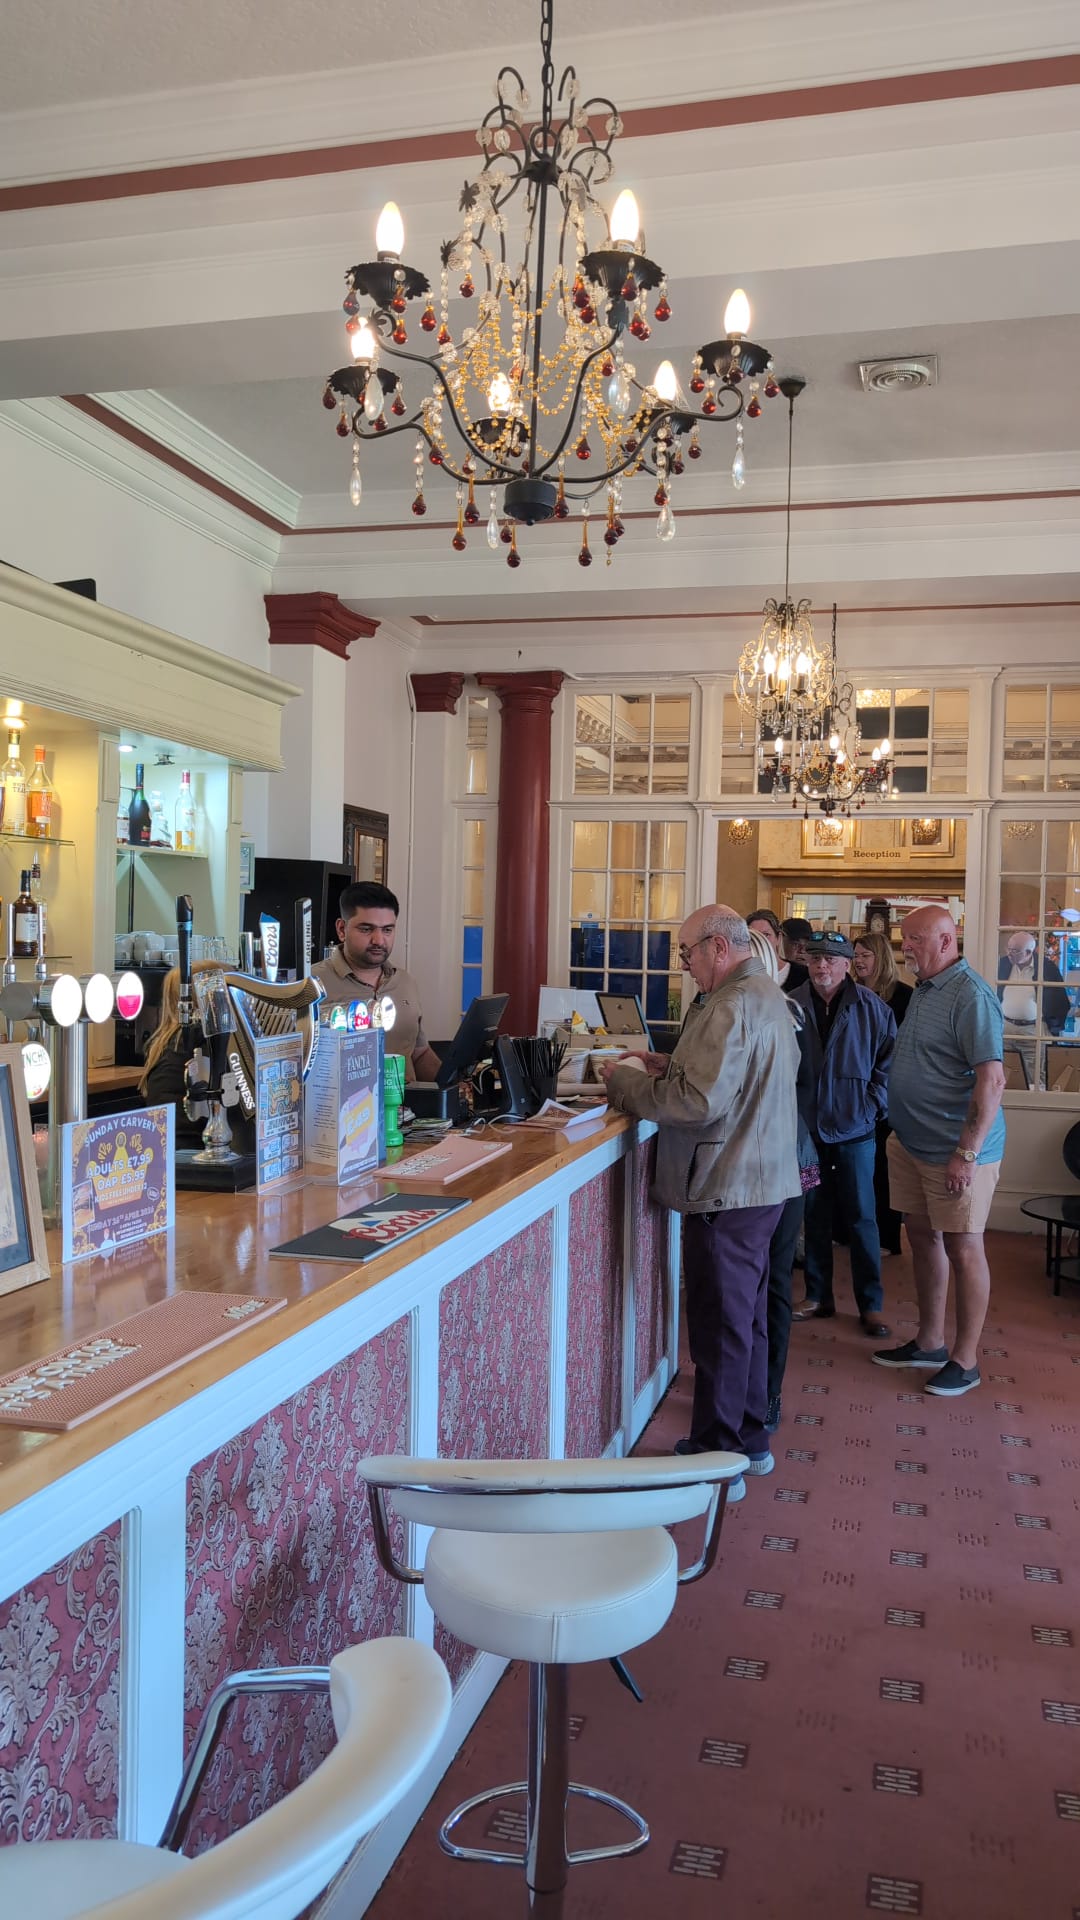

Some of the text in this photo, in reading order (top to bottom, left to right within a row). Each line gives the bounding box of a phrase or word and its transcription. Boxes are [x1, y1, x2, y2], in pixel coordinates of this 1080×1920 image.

[853, 850, 901, 860] Reception
[265, 925, 279, 967] Coors
[229, 1052, 256, 1110] GUINNESS
[84, 1116, 157, 1147] SUNDAY CARVERY
[86, 1160, 124, 1178] ADULTS
[97, 1176, 118, 1191] OAP
[341, 1208, 437, 1242] Coors
[35, 1358, 82, 1377] ON
